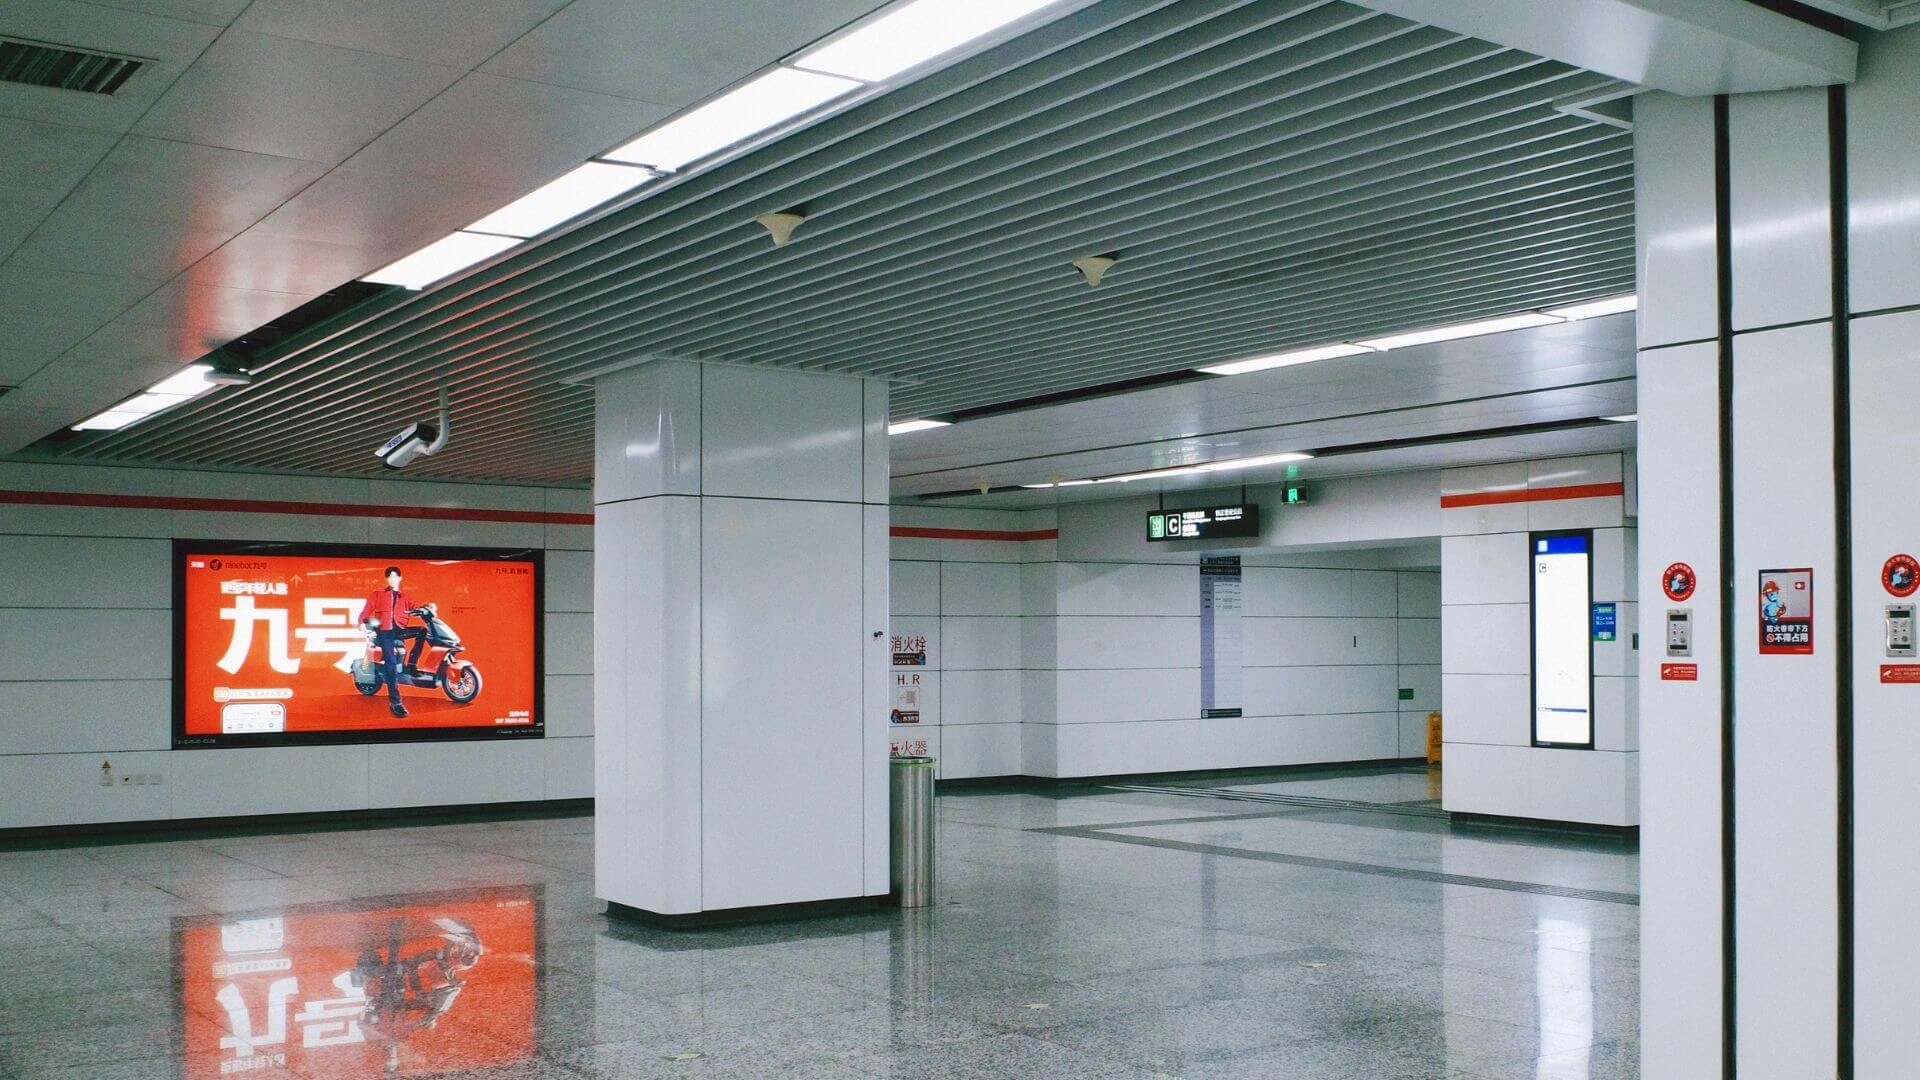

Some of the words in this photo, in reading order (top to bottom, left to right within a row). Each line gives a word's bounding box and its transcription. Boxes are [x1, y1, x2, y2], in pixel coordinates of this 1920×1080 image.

[1169, 518, 1178, 533] C
[216, 596, 367, 674] 九号
[1775, 633, 1808, 642] 不得占用
[890, 636, 927, 651] 消火栓
[912, 674, 920, 684] R
